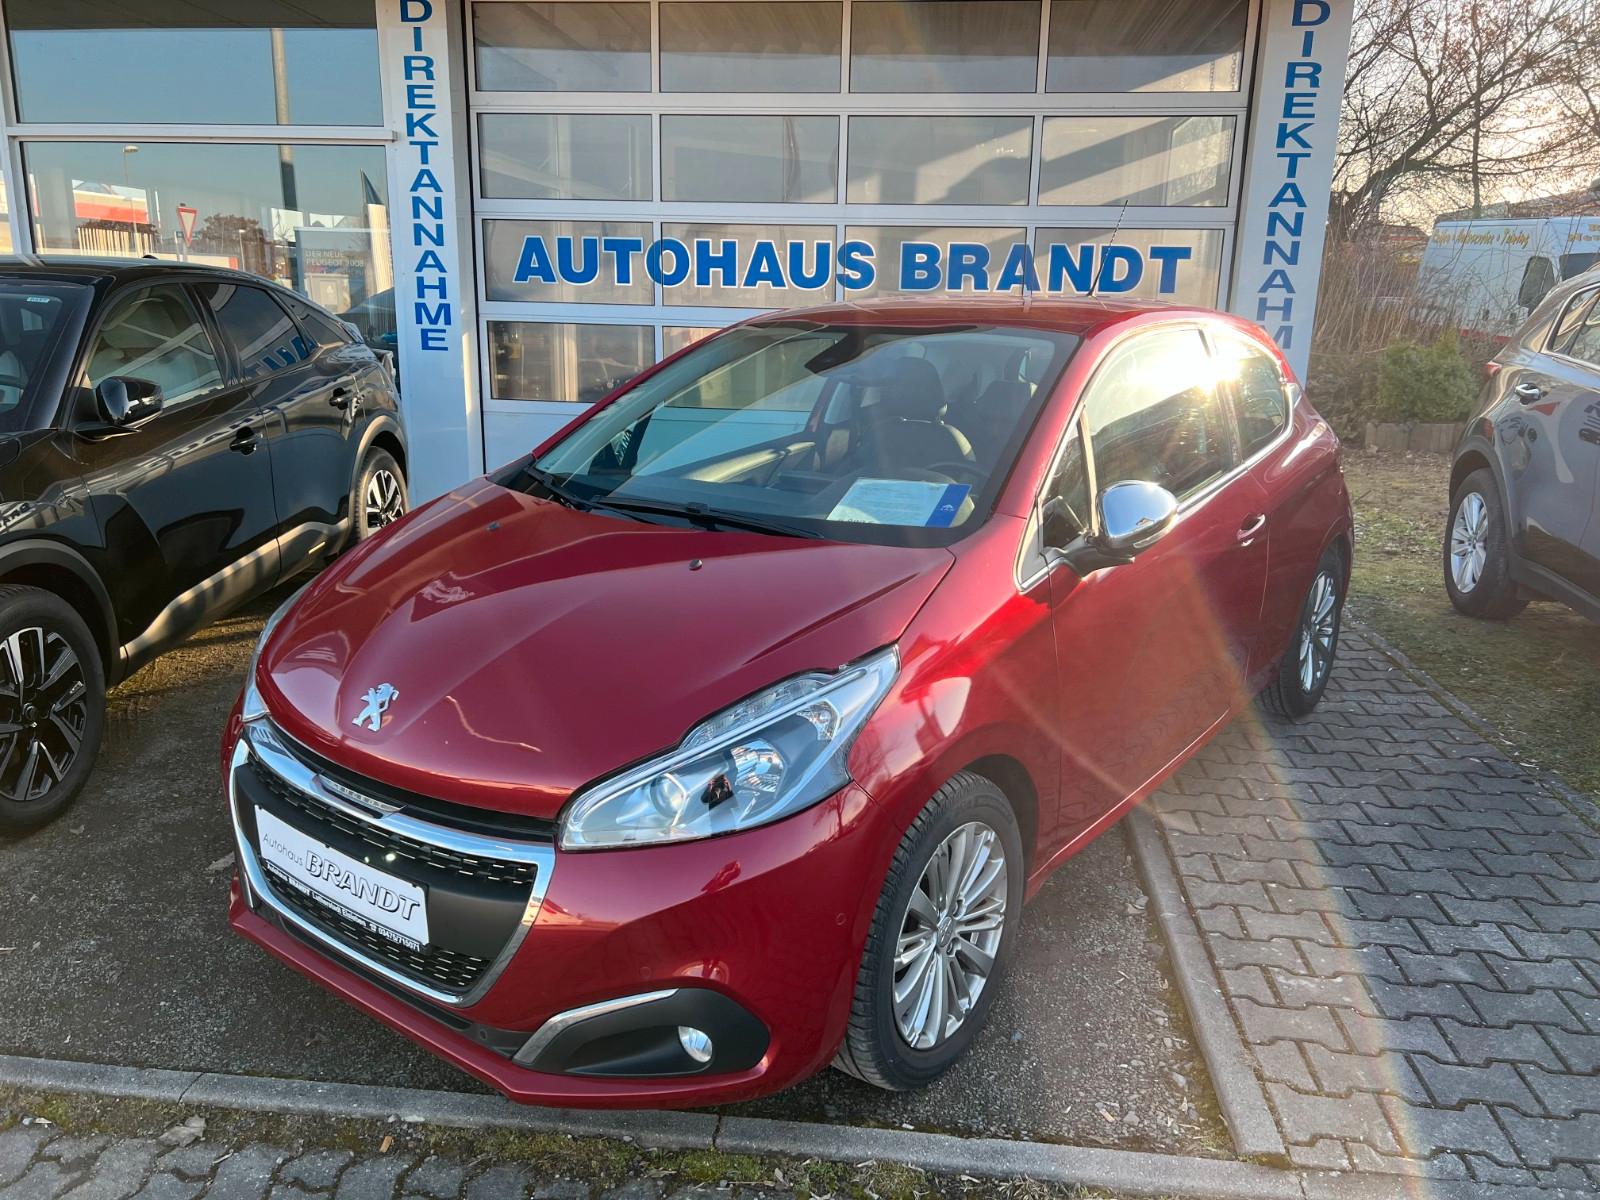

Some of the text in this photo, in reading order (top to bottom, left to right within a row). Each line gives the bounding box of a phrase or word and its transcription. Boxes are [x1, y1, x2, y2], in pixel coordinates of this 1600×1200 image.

[400, 0, 452, 351] DIREKTANNAHME
[512, 235, 1193, 295] AUTOHAUS BRANDT
[263, 833, 420, 921] Autohaus BRANDT
